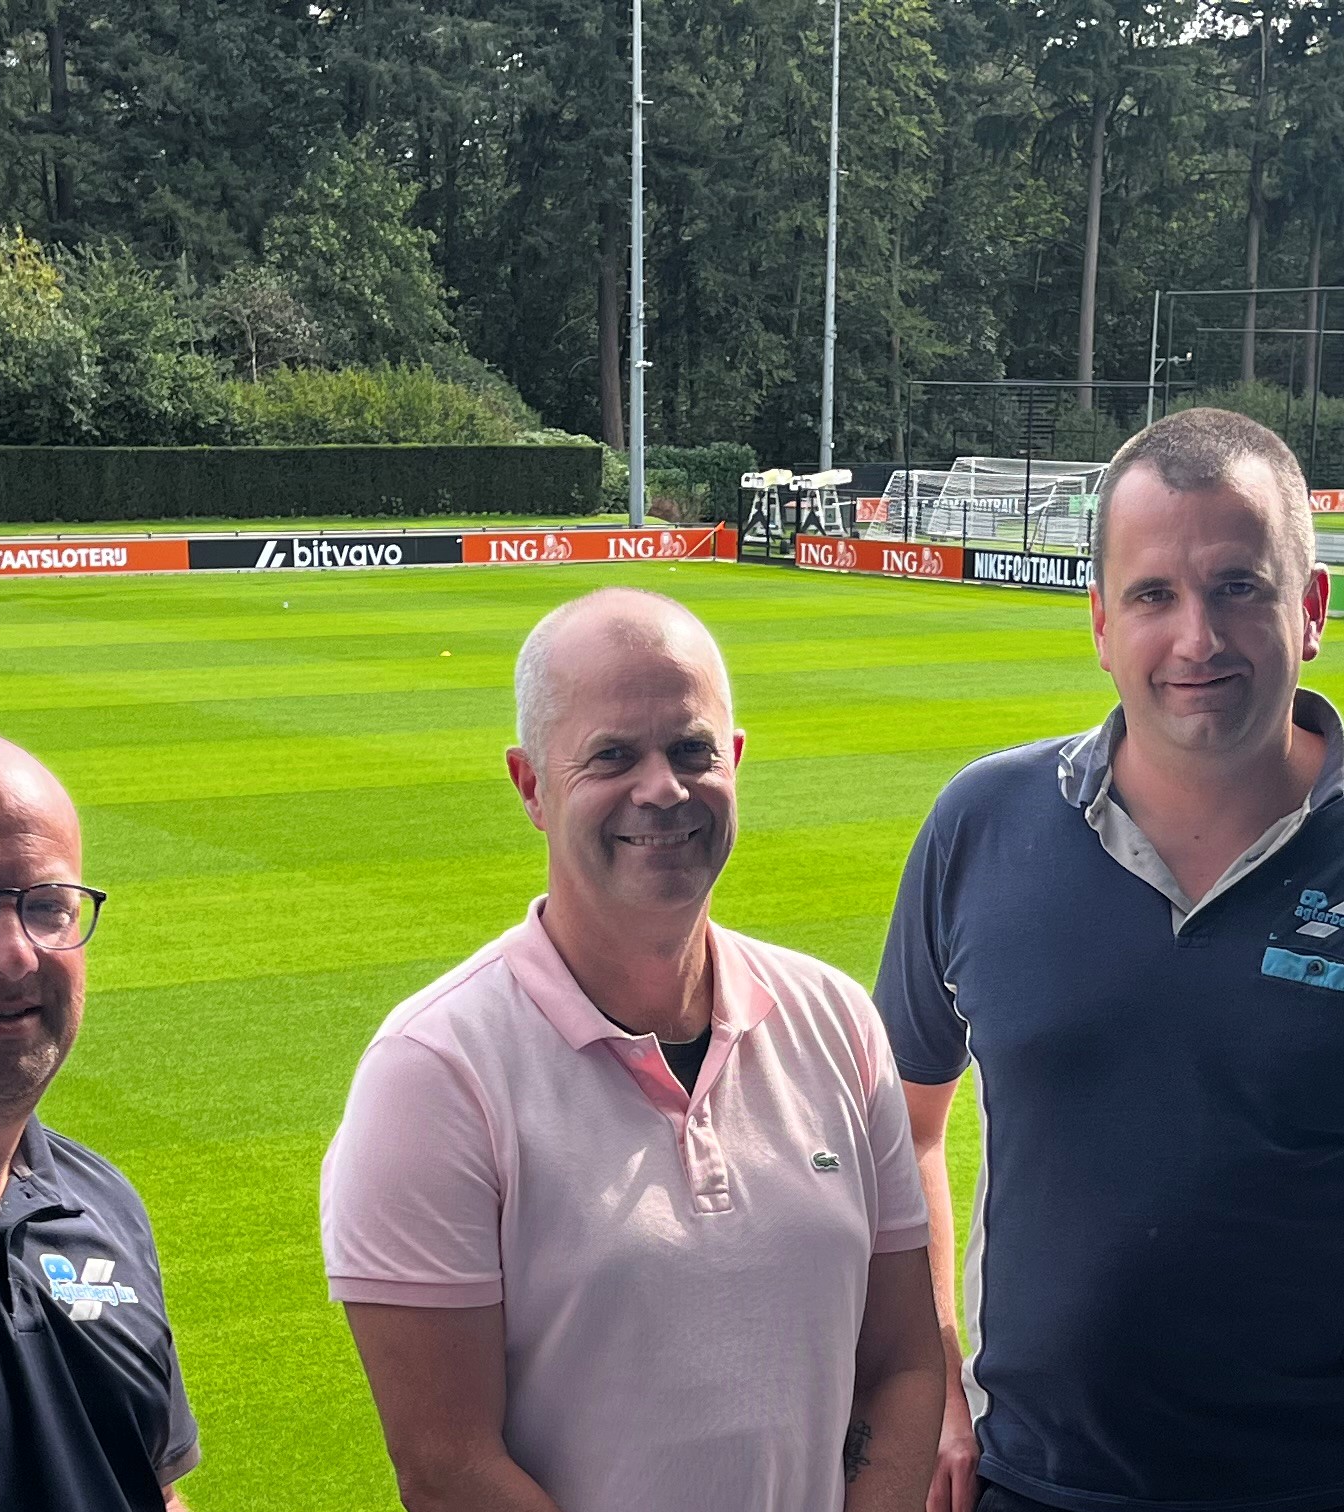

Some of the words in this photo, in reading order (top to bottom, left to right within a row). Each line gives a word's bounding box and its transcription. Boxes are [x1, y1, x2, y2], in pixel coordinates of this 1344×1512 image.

[1309, 494, 1331, 511] NG
[294, 539, 403, 567] bitvavo
[489, 539, 537, 562] ING
[607, 537, 654, 559] ING
[800, 542, 833, 566] ING
[882, 548, 917, 573] ING
[974, 551, 1093, 588] NIKEFOOTBALL.CO
